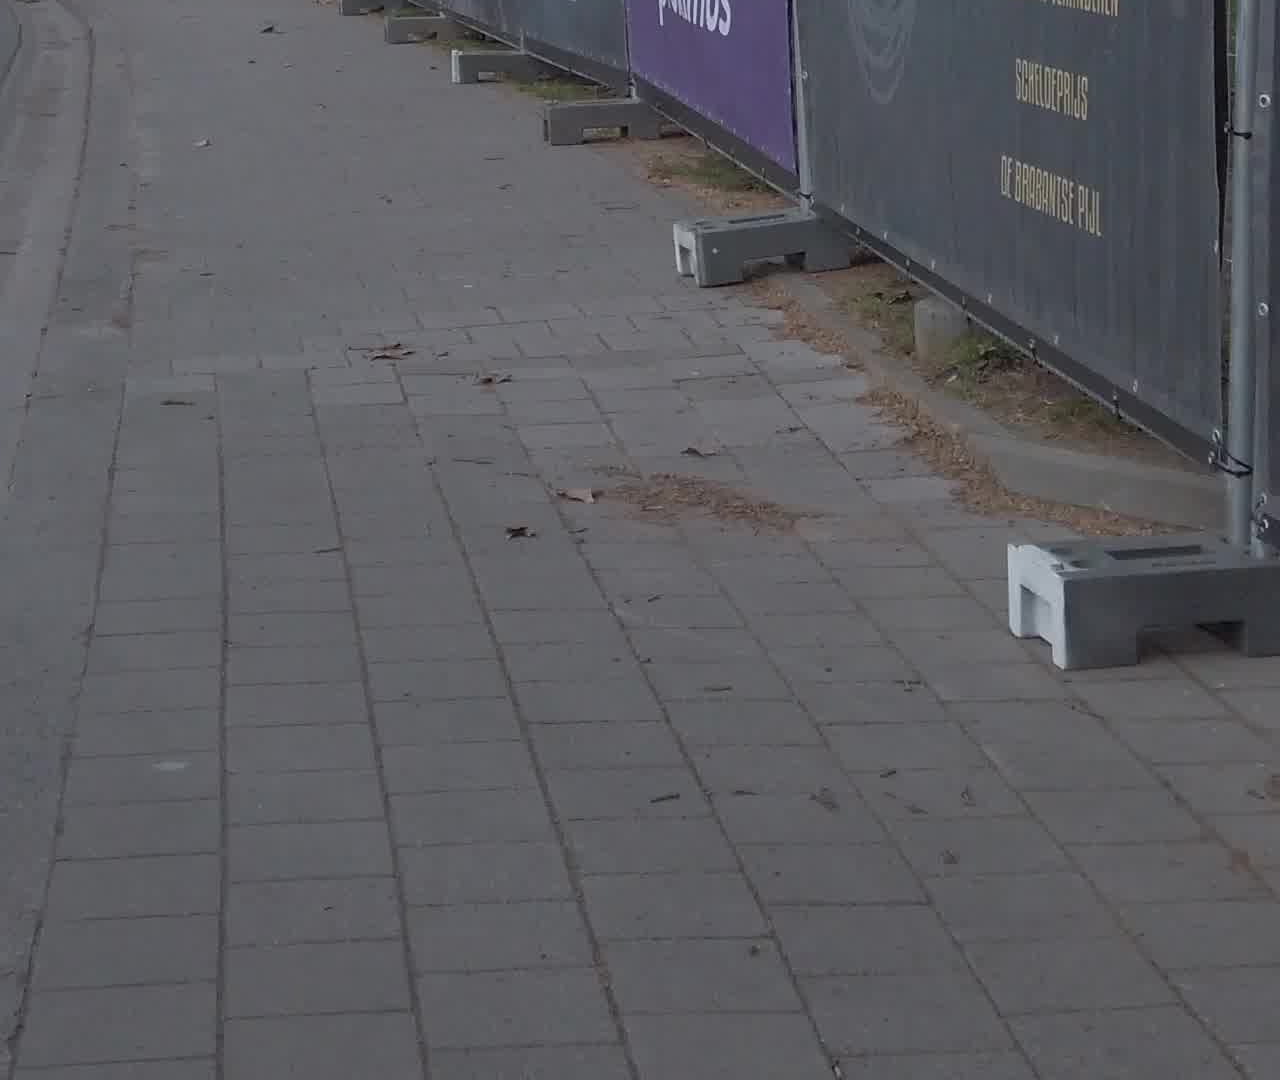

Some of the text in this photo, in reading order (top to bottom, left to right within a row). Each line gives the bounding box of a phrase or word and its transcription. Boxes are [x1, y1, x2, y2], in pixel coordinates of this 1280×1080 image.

[1015, 58, 1089, 121] SCHELDEPRIJS
[1000, 155, 1102, 237] DE BRABANTSE PIJL
